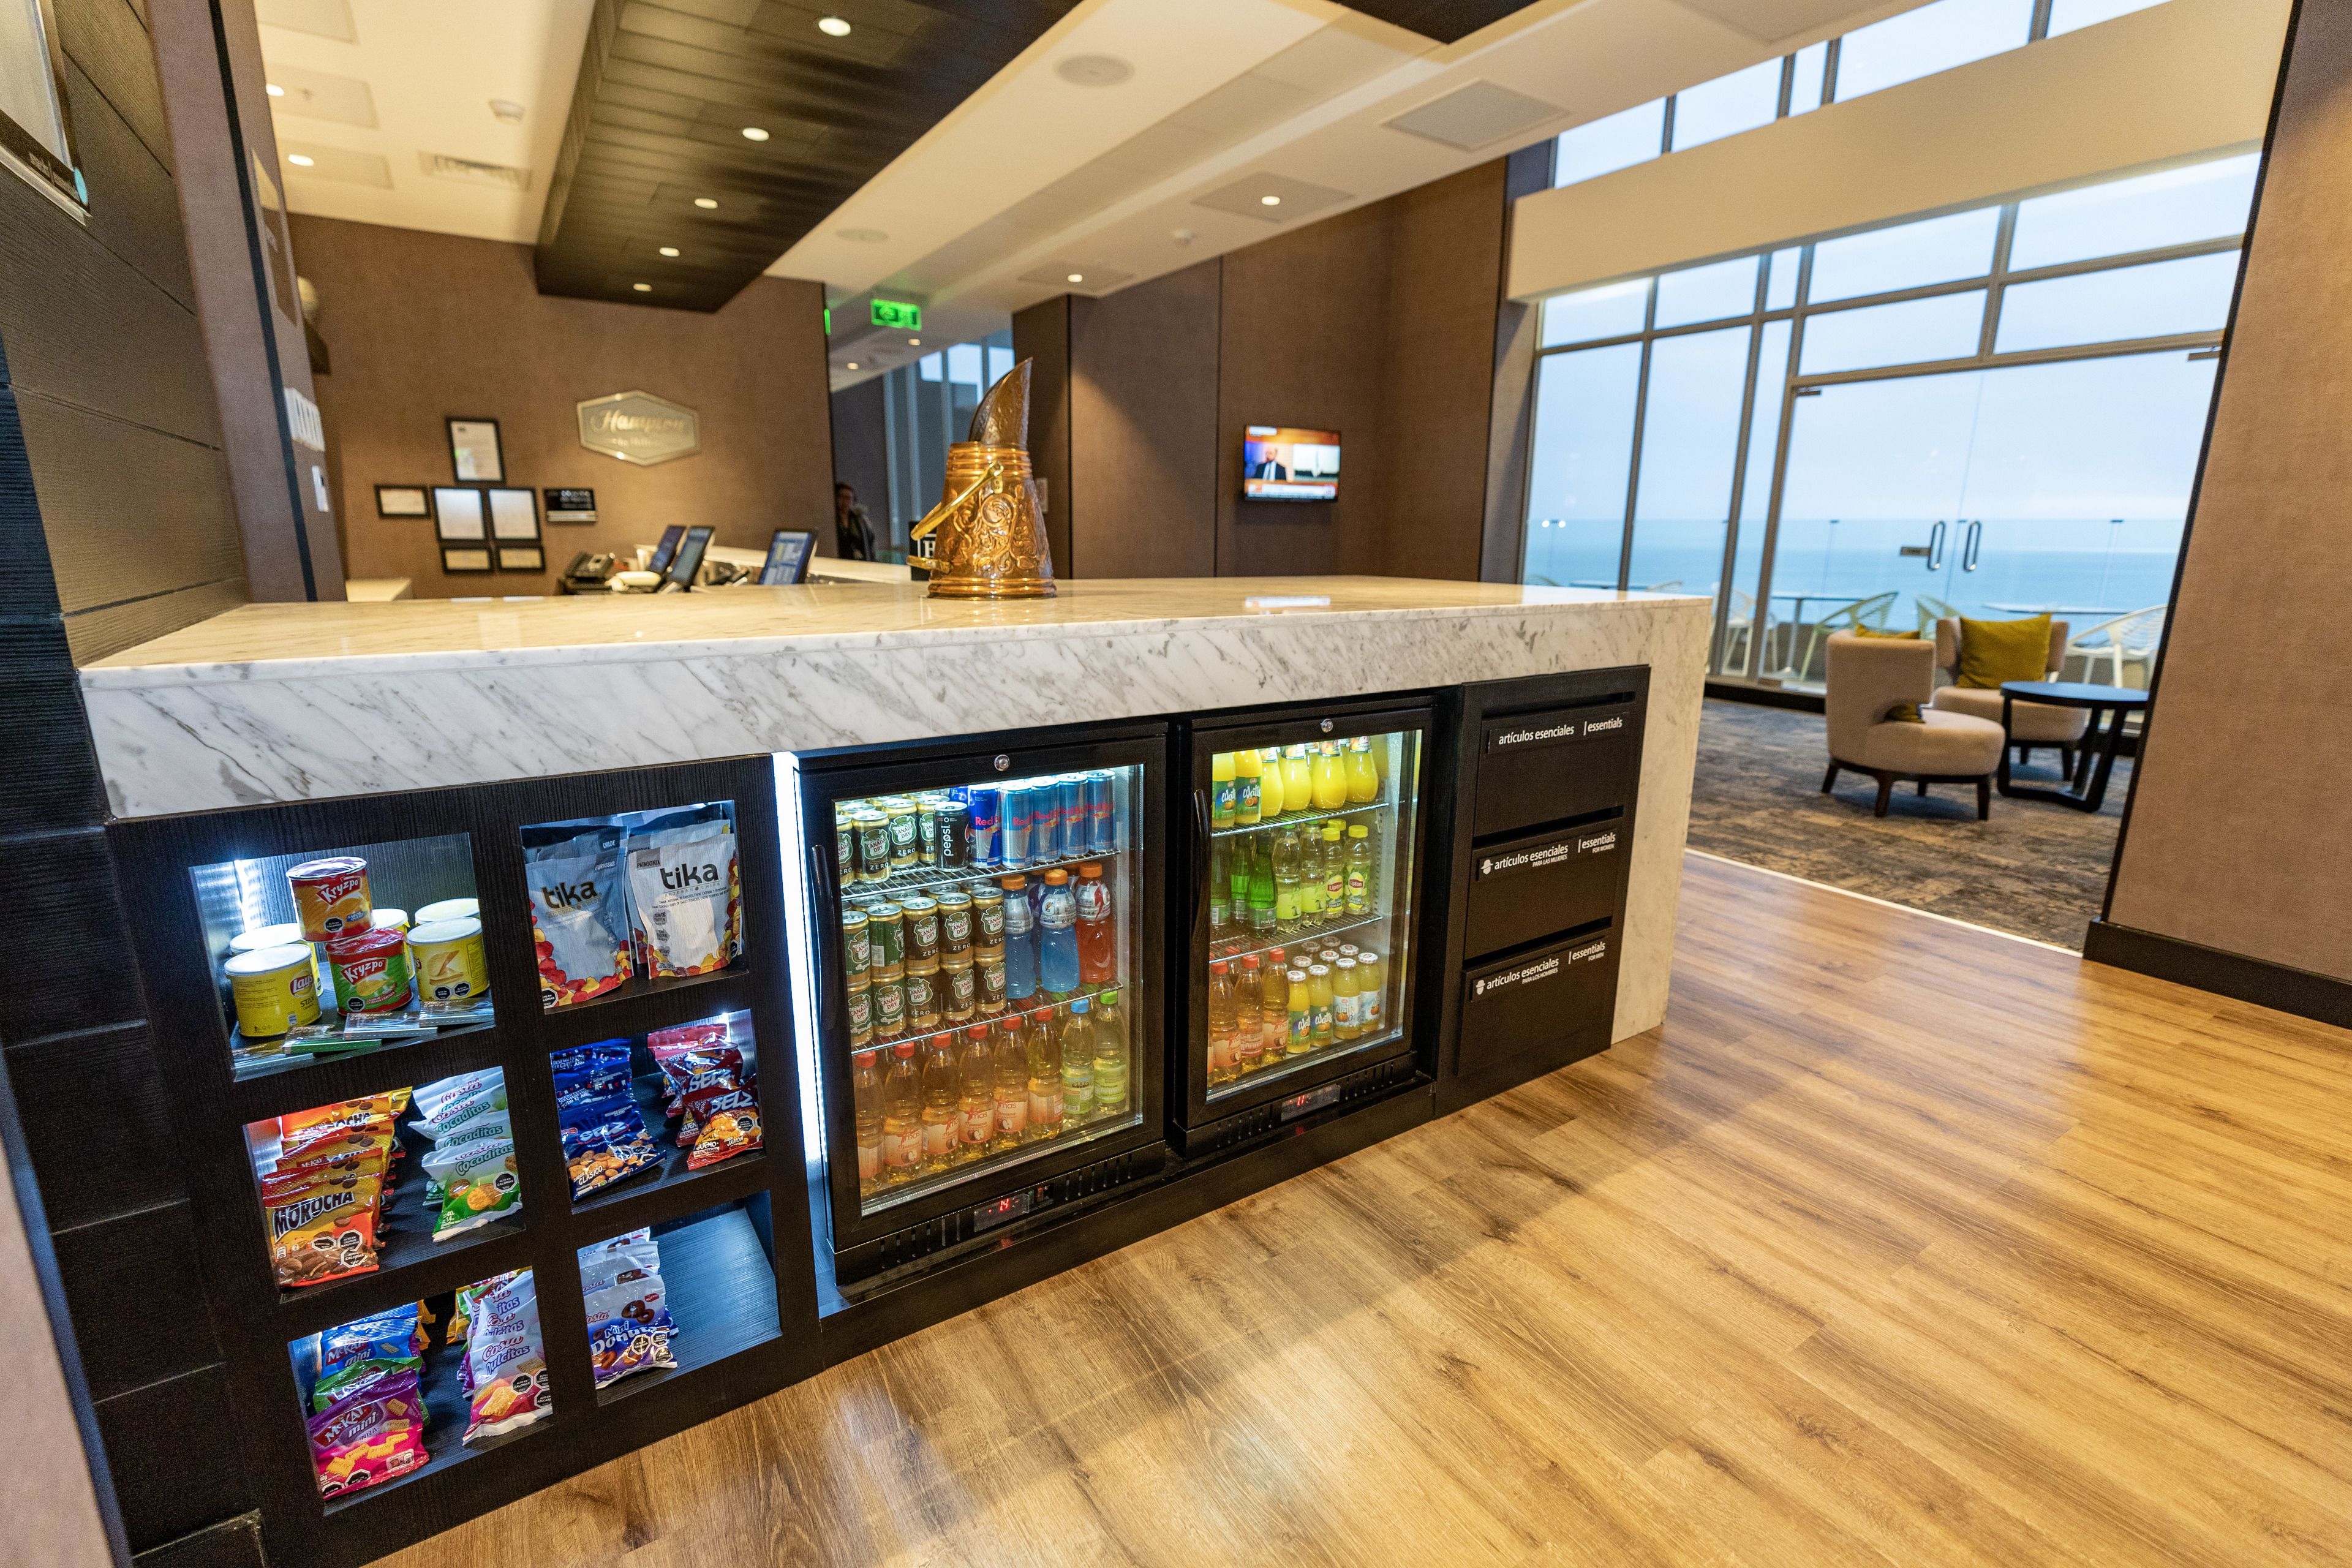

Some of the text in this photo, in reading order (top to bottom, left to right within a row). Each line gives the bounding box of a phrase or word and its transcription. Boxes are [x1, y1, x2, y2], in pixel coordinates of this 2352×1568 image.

[1499, 717, 1623, 745] artículos esenciales essentials
[895, 824, 913, 835] CANADA
[975, 816, 993, 826] Red
[838, 843, 849, 851] NADA
[867, 838, 886, 849] CANADA
[941, 824, 954, 856] pepsi
[1494, 832, 1616, 870] artículos esenciales essentials
[637, 859, 660, 868] PATAGONIA
[839, 867, 853, 875] ERO
[870, 862, 889, 870] ZERO
[660, 863, 719, 889] tika
[321, 879, 358, 903] Kryzpo
[541, 881, 598, 910] tika
[665, 888, 693, 897] ARTESAN
[701, 882, 721, 891] CHIPS
[950, 920, 968, 931] CANADA
[989, 936, 1005, 944] ZERO
[922, 947, 939, 956] ZERO
[344, 960, 383, 983] Kryzpo
[1487, 941, 1605, 990] artículos esenciales essentials
[880, 994, 900, 1006] CANADA
[911, 987, 927, 995] ANADA
[300, 995, 315, 1008] STAX
[850, 1002, 869, 1016] CANADA
[857, 1011, 867, 1019] DRY
[710, 1090, 754, 1116] SELZ
[435, 1101, 491, 1134] Cocaditas
[445, 1126, 503, 1147] Cocaditas
[456, 1144, 515, 1177] Cocaditas
[578, 1165, 603, 1186] CLASICO
[274, 1191, 355, 1240] MOROCHA
[497, 1297, 521, 1316] itas
[605, 1321, 630, 1338] Mini
[344, 1348, 372, 1367] mini
[482, 1336, 524, 1362] Costa
[485, 1346, 530, 1375] Dulcitas
[325, 1404, 370, 1442] McKAY
[347, 1411, 377, 1438] mini
